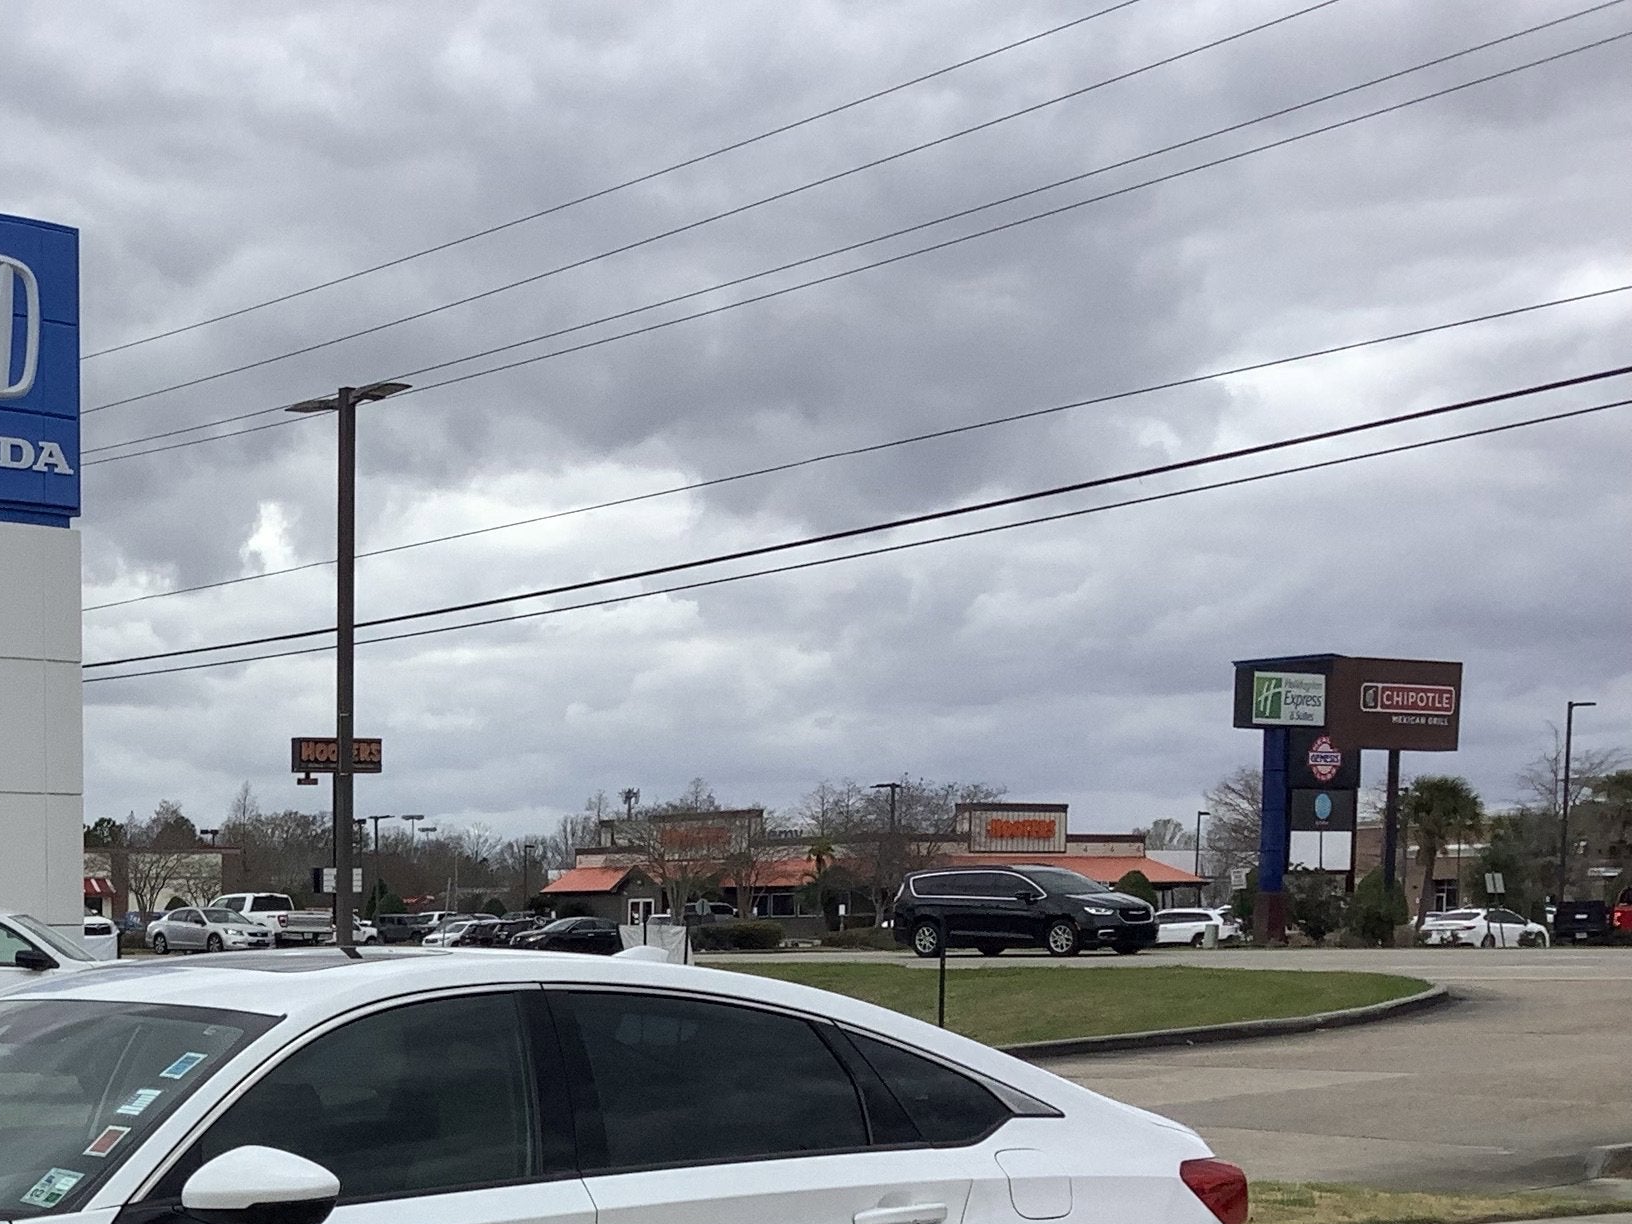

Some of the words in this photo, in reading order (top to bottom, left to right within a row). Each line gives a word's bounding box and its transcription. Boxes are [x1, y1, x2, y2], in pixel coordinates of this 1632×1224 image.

[1284, 690, 1323, 709] Express
[1383, 691, 1450, 708] CHIPOTLE
[1392, 715, 1426, 724] MEXICAN
[301, 741, 381, 762] HOOERS
